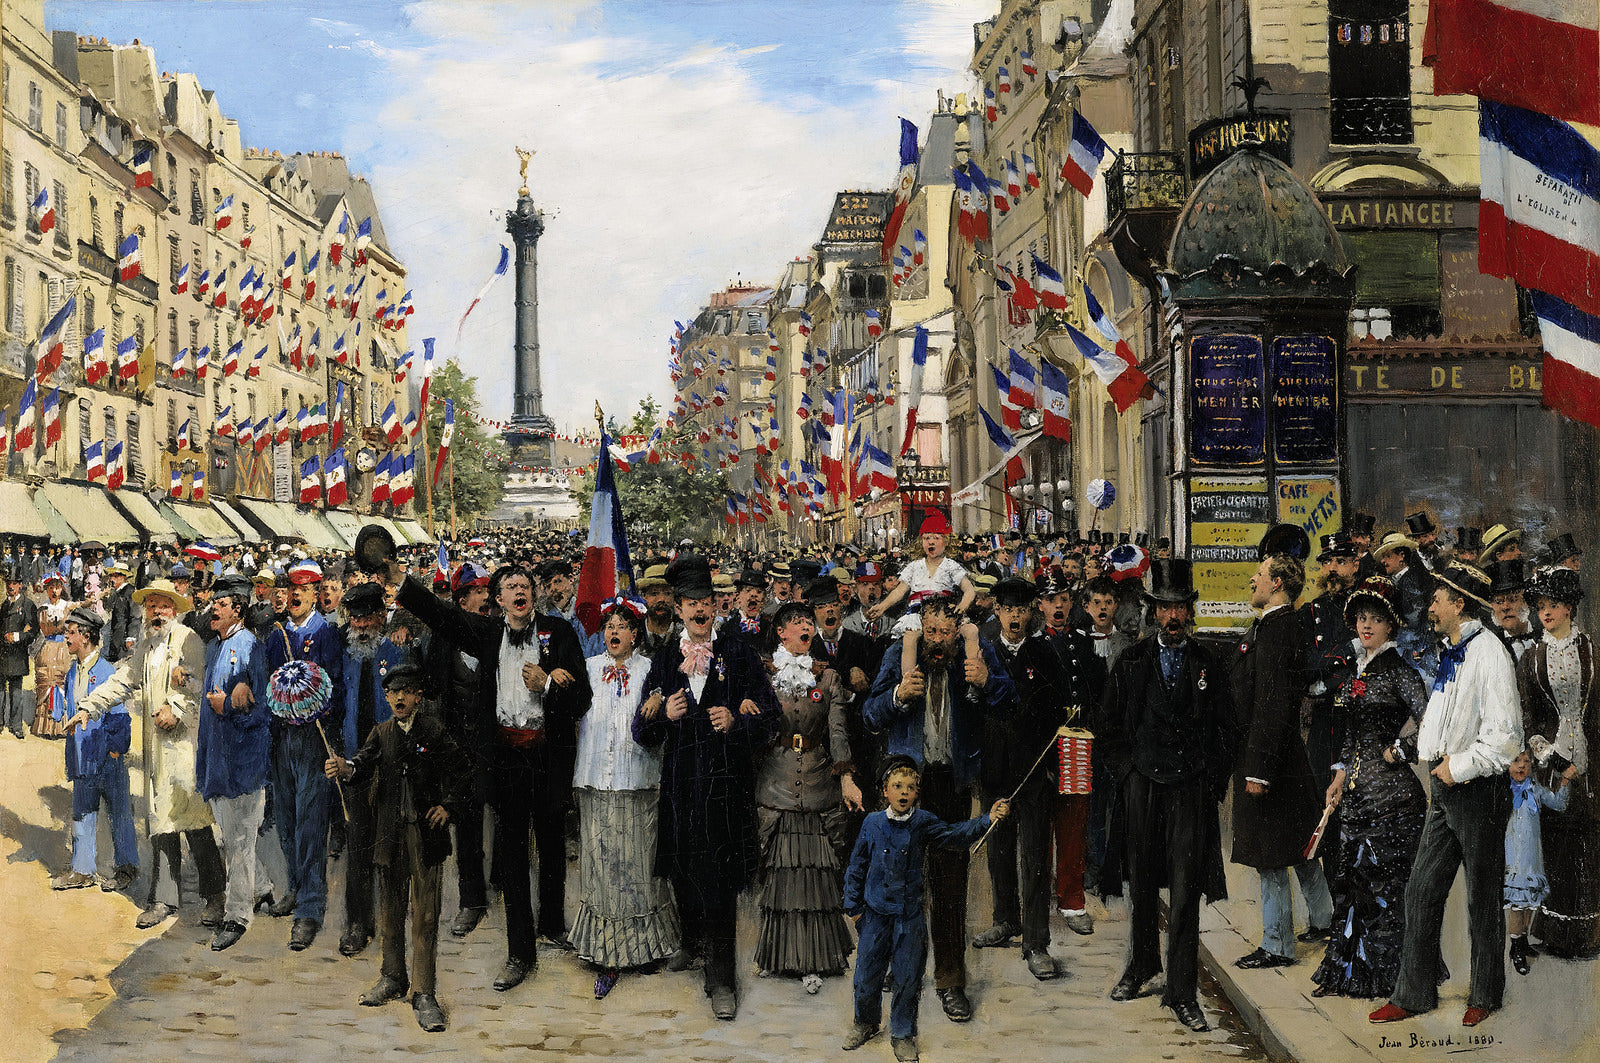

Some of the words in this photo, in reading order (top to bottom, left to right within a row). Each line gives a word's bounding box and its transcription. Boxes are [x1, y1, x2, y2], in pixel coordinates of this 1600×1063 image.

[1430, 365, 1463, 389] DE
[1197, 396, 1260, 409] MENIER
[906, 490, 945, 503] VINS
[1279, 484, 1308, 499] CAFE
[1378, 1036, 1402, 1048] Jean
